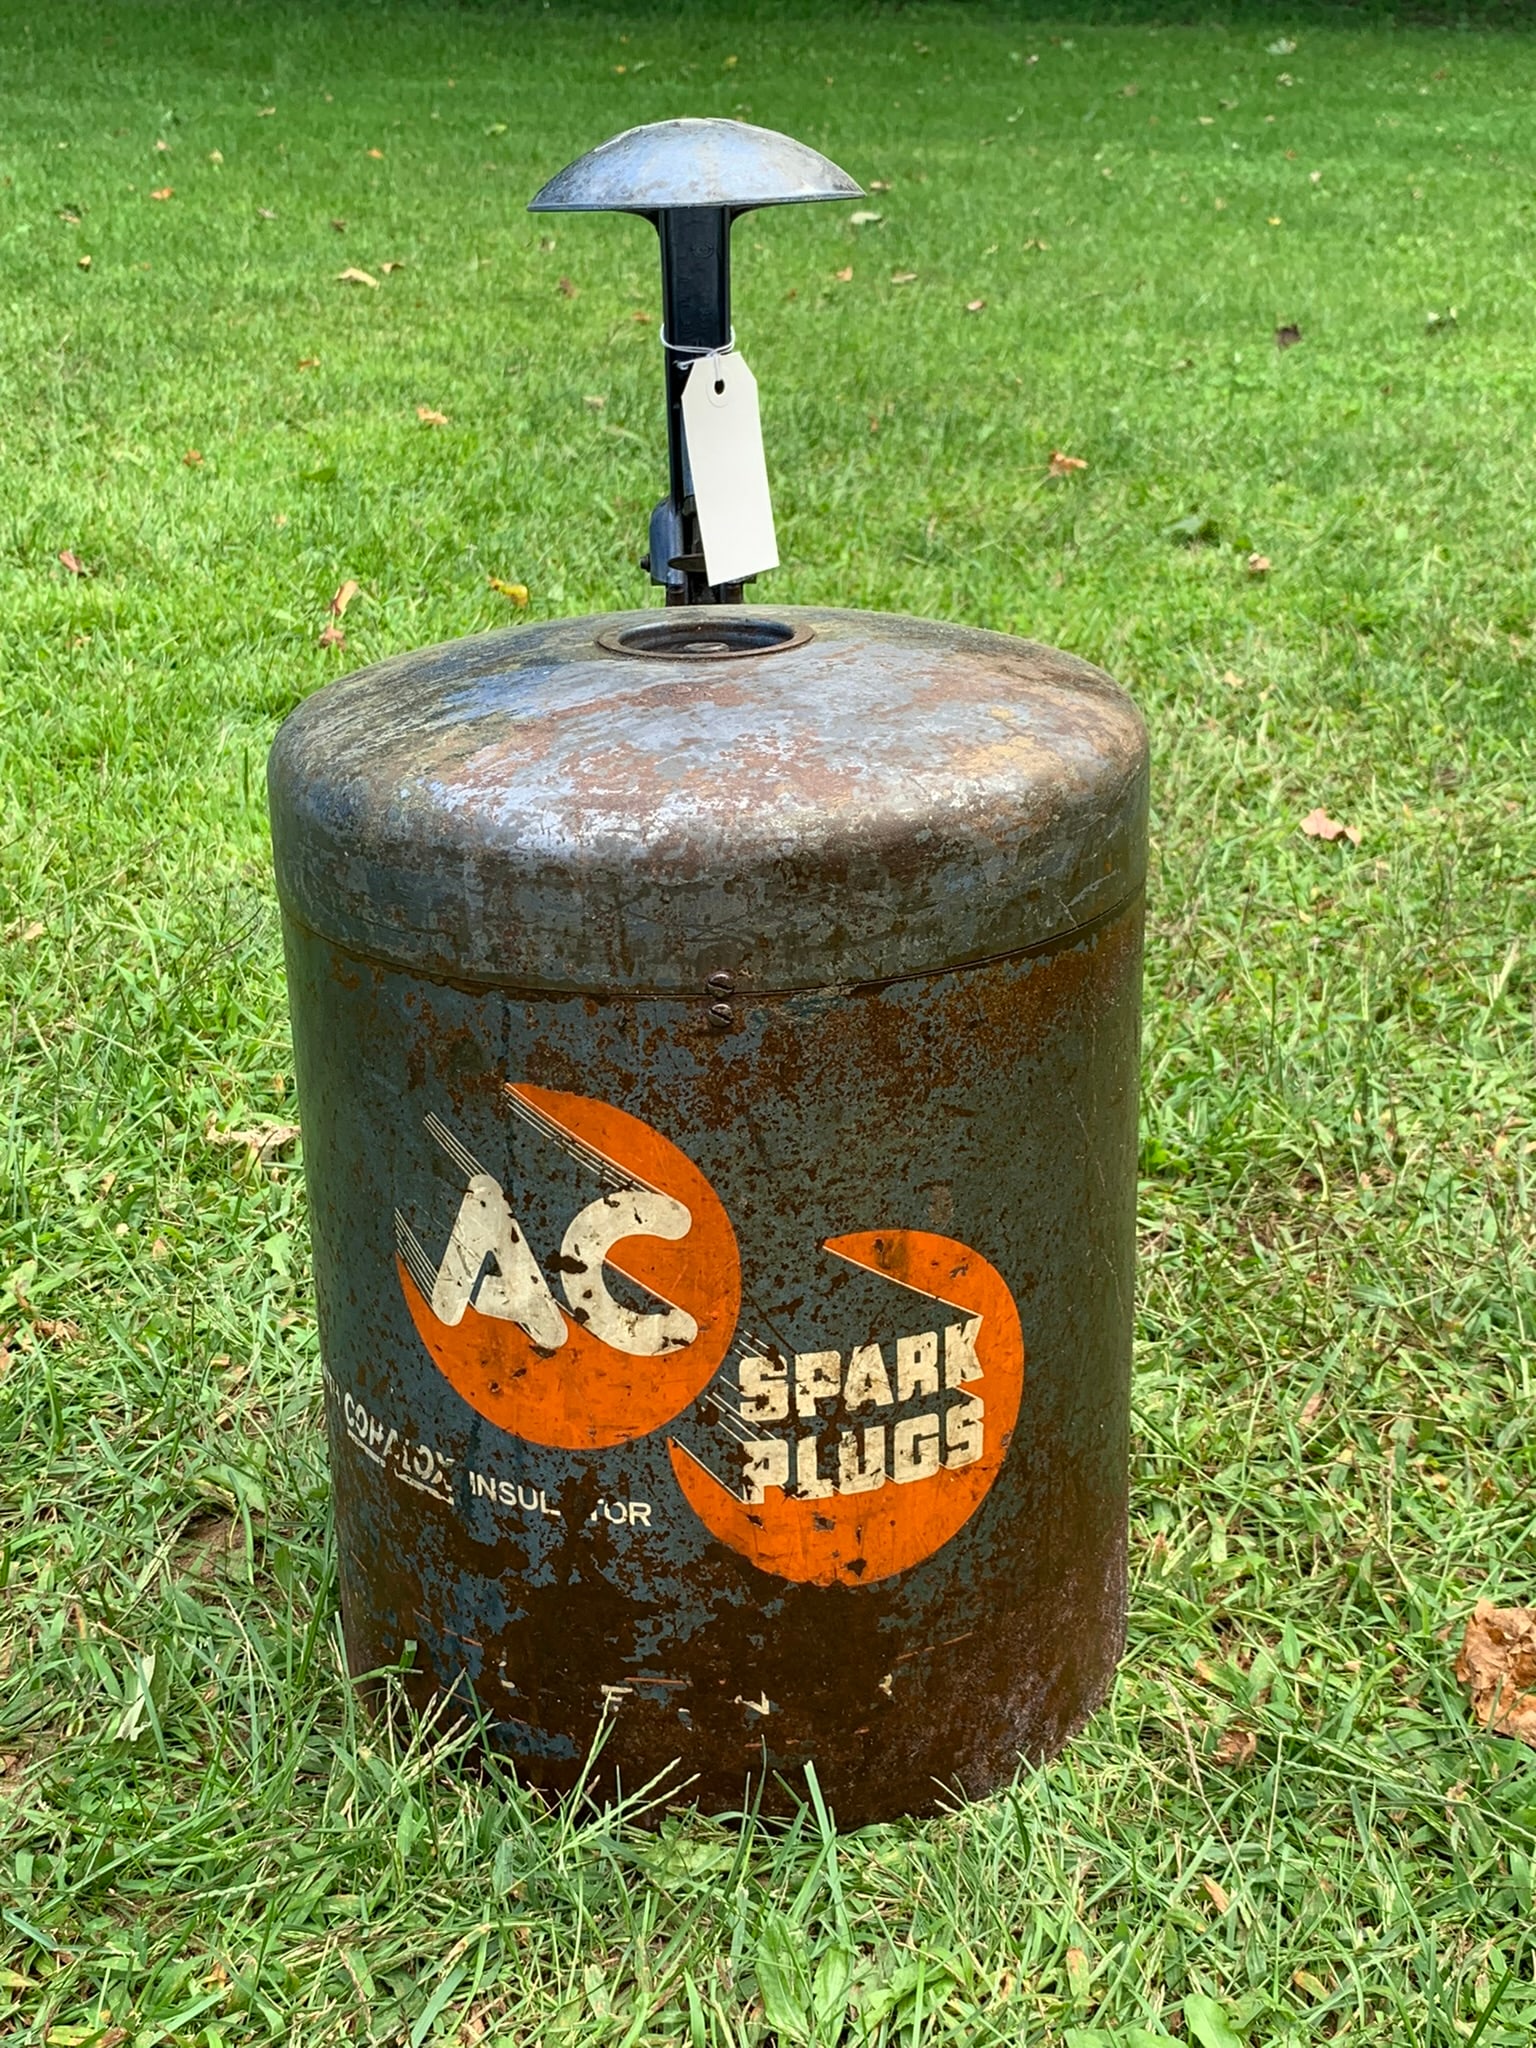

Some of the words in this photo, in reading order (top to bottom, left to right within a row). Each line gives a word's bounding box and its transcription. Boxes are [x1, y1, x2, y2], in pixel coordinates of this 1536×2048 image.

[432, 1174, 698, 1356] AC
[739, 1316, 984, 1421] SPARK
[469, 1470, 652, 1527] INSULTOR
[742, 1396, 984, 1504] PLUGS
